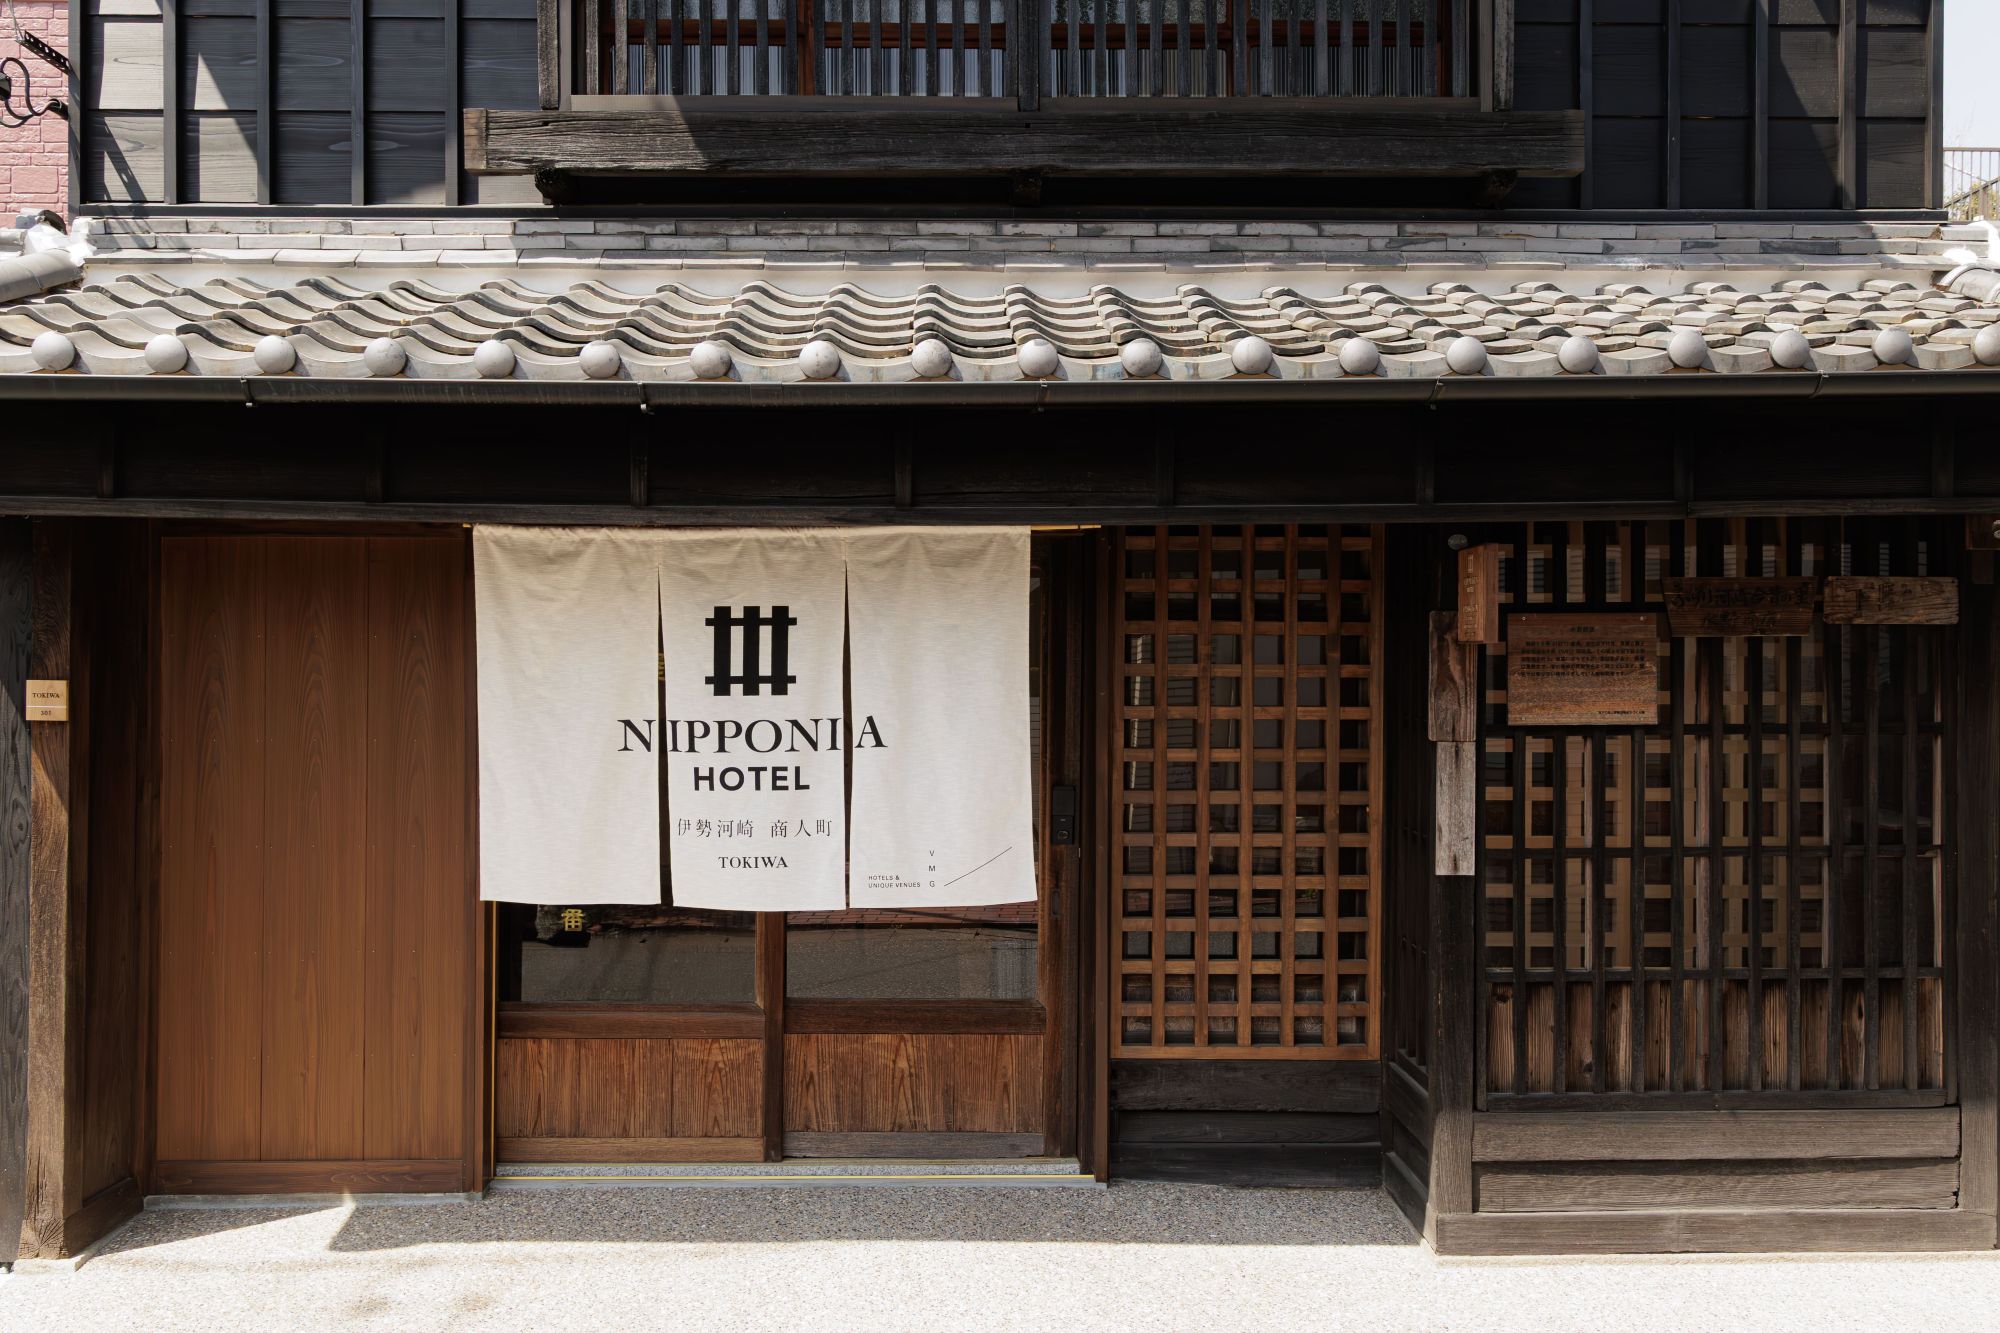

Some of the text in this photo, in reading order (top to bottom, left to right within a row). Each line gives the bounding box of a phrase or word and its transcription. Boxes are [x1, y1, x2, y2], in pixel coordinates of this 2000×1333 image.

[617, 715, 888, 753] NIPPONIA
[693, 766, 810, 792] HOTEL
[770, 818, 833, 838] 商人町
[718, 856, 789, 869] TOKIWA
